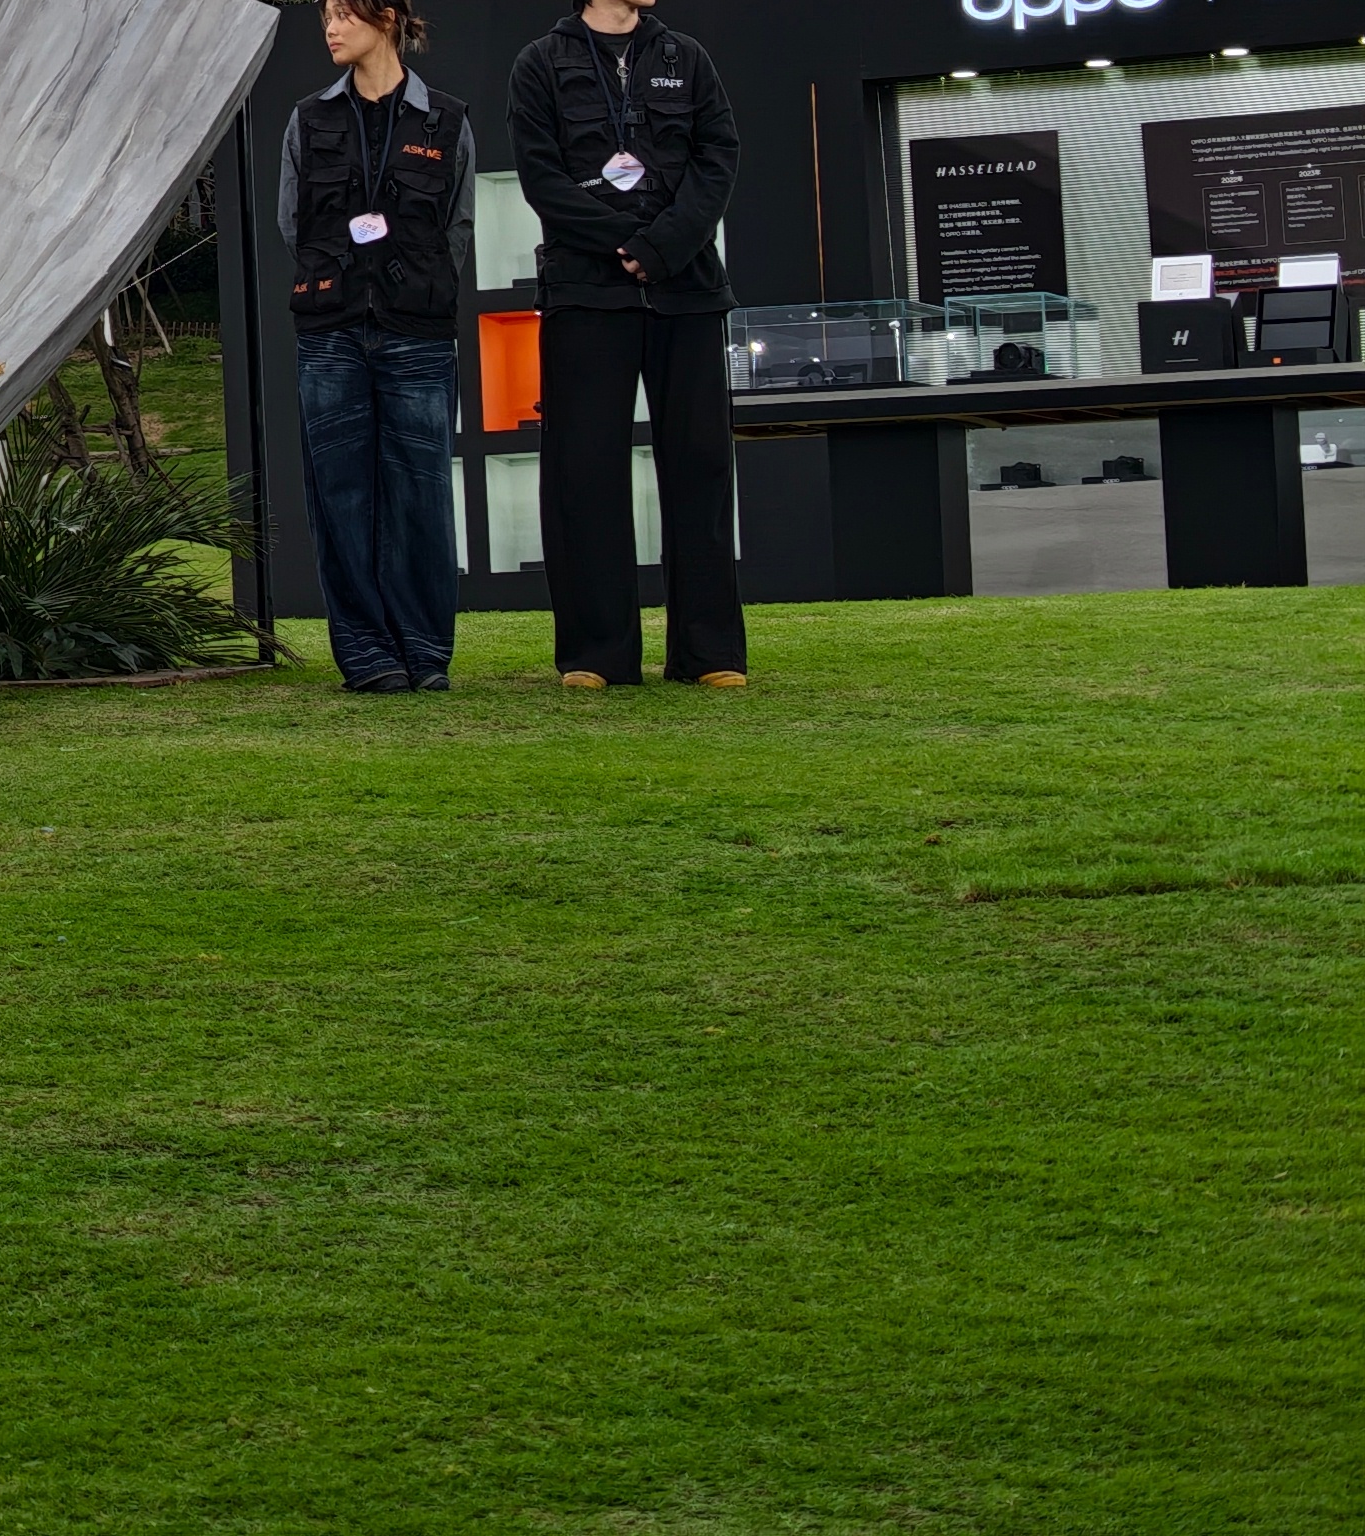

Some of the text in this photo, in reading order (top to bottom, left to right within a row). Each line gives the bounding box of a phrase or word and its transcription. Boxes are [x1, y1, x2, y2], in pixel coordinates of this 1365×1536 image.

[650, 77, 684, 89] STAFF
[402, 144, 443, 161] ASK ME
[936, 160, 1037, 177] HASSELBLAD
[294, 279, 333, 294] ASK ME
